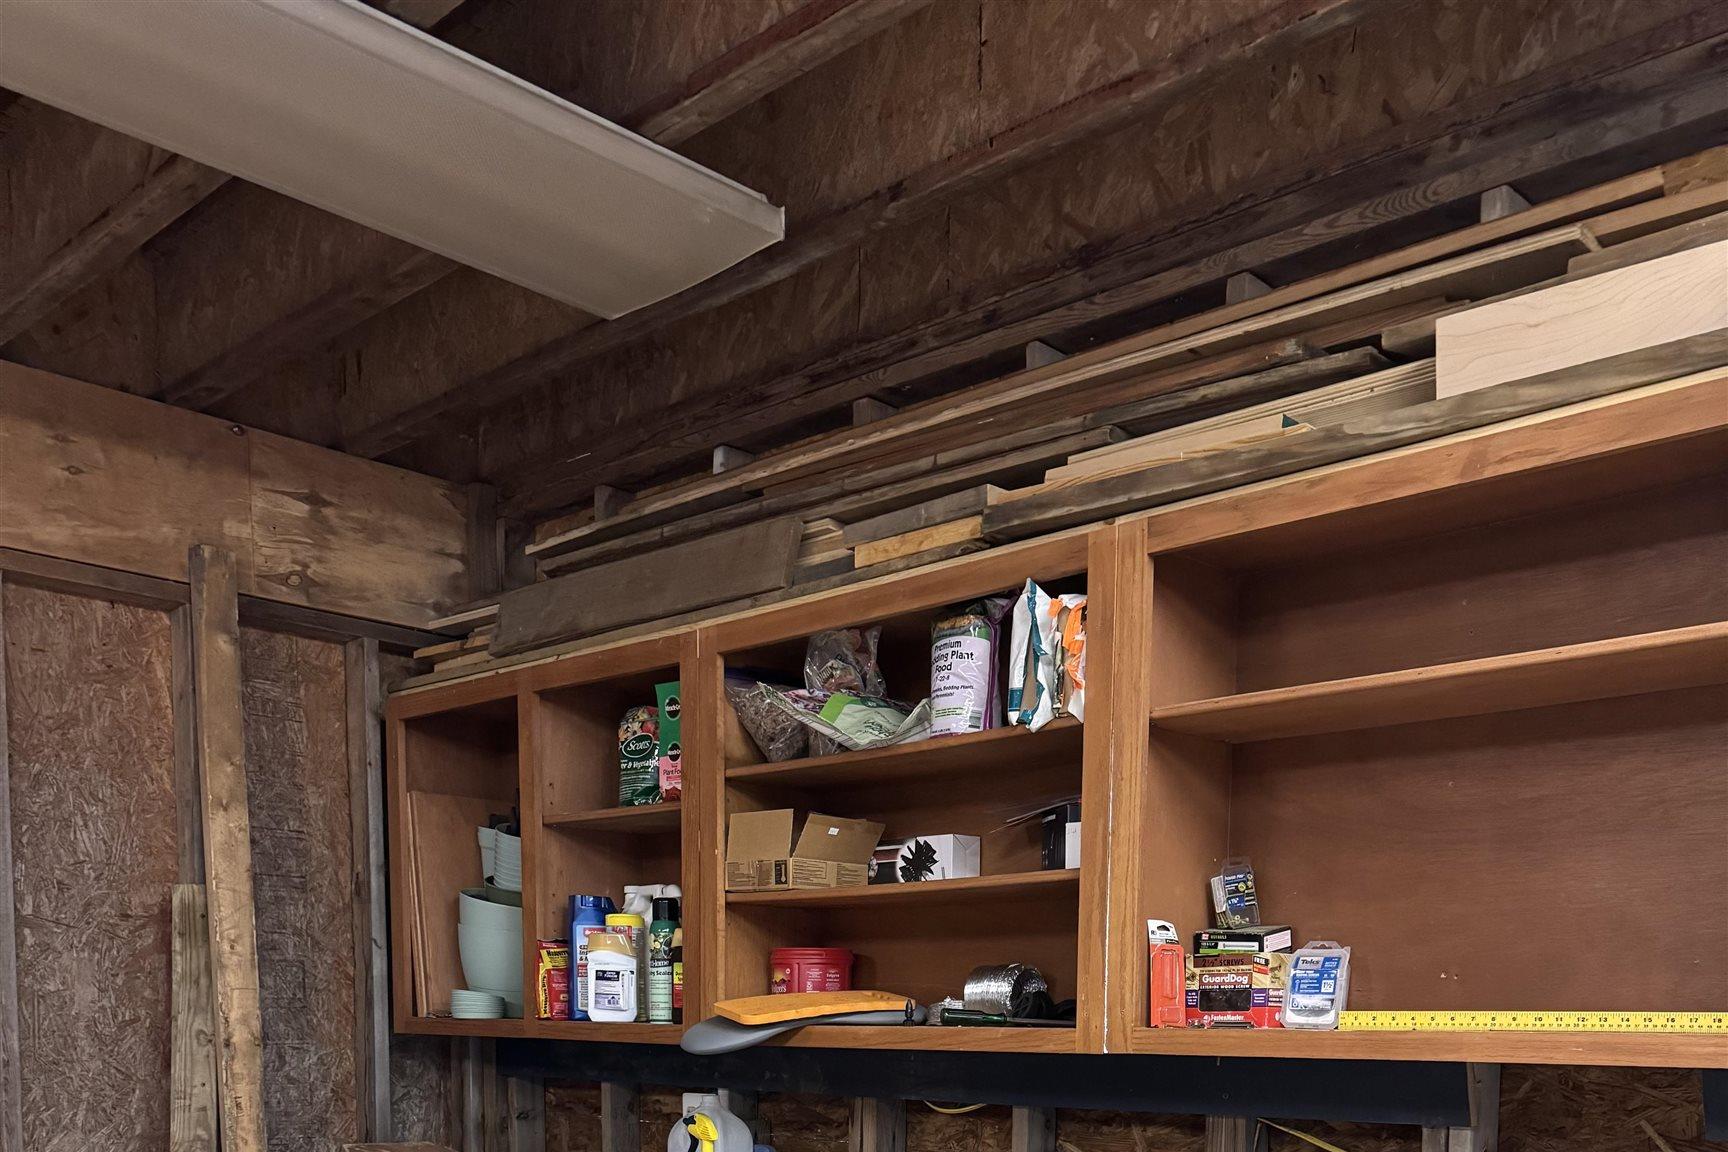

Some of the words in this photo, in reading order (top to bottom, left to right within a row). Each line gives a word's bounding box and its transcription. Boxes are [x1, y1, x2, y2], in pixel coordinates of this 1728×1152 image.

[934, 640, 962, 653] Premium
[950, 650, 975, 662] Plant
[934, 661, 952, 674] Food
[626, 740, 651, 751] Scotts
[1219, 958, 1245, 966] SCREWS
[1202, 973, 1249, 984] GuardDog
